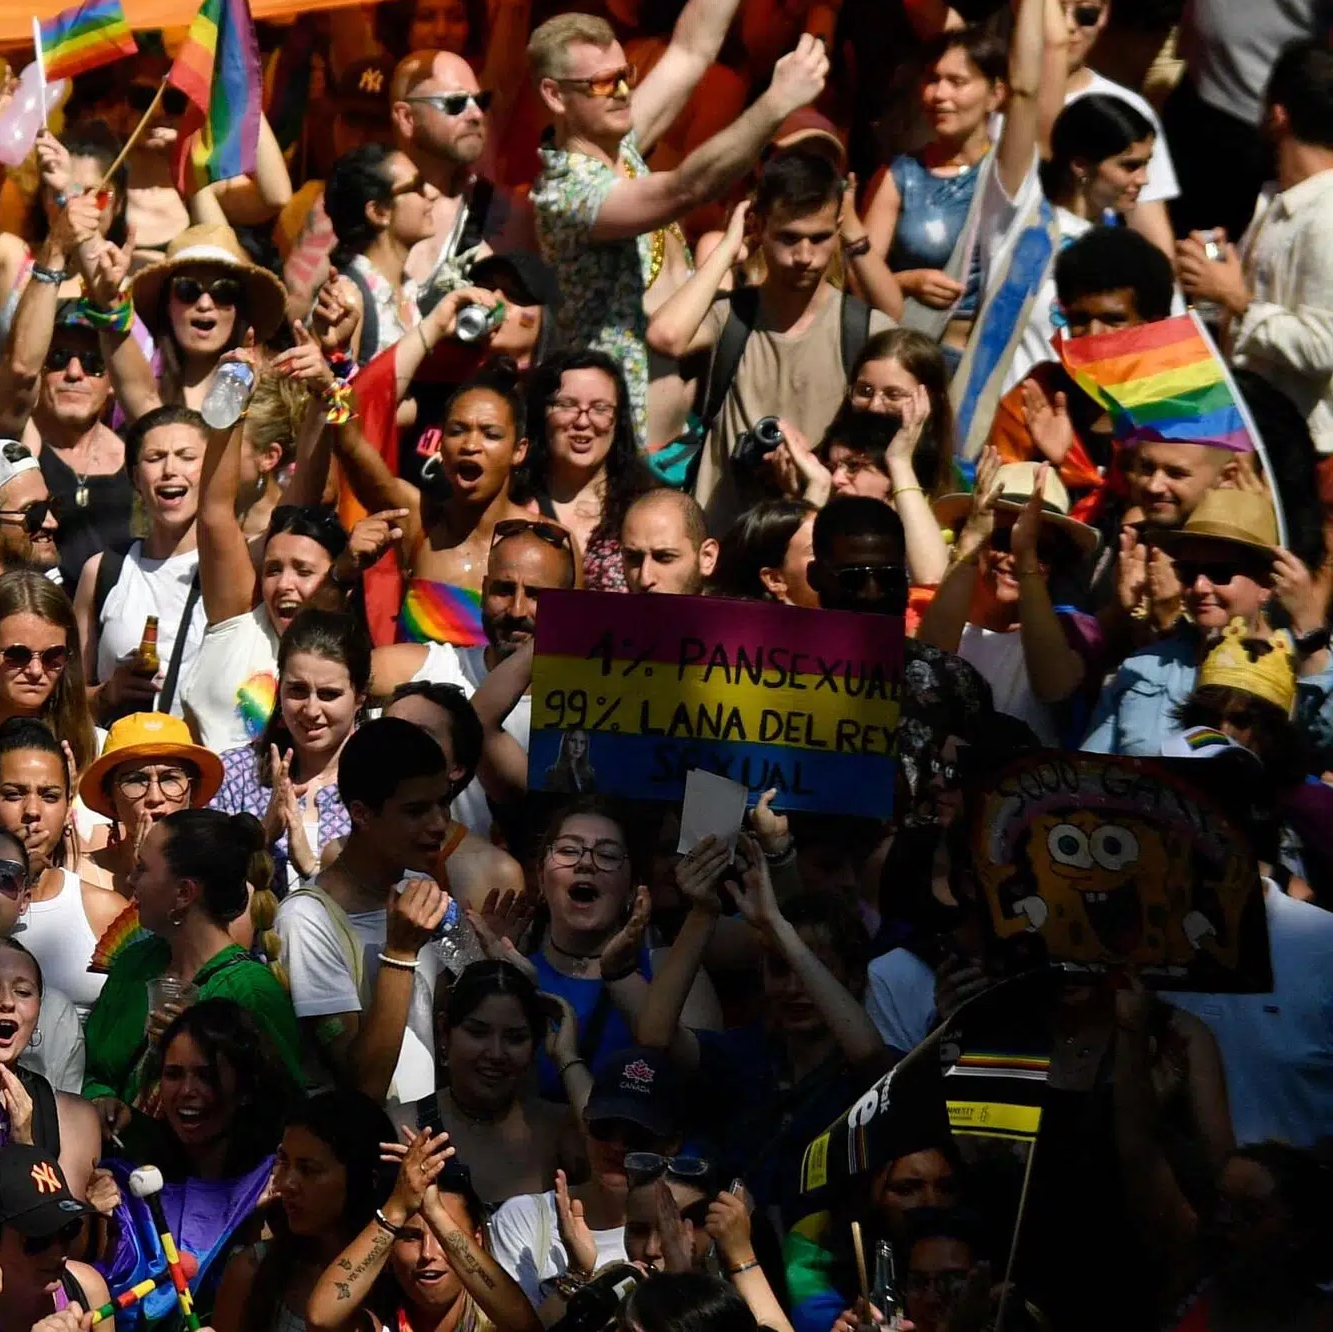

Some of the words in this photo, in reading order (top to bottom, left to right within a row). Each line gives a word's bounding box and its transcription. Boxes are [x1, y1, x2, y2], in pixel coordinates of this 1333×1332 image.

[586, 629, 656, 679] 1%
[543, 688, 622, 733] 99%
[639, 699, 748, 742] LANA
[758, 708, 829, 748] DEL
[835, 717, 901, 755] REY
[618, 1081, 651, 1094] CANADA
